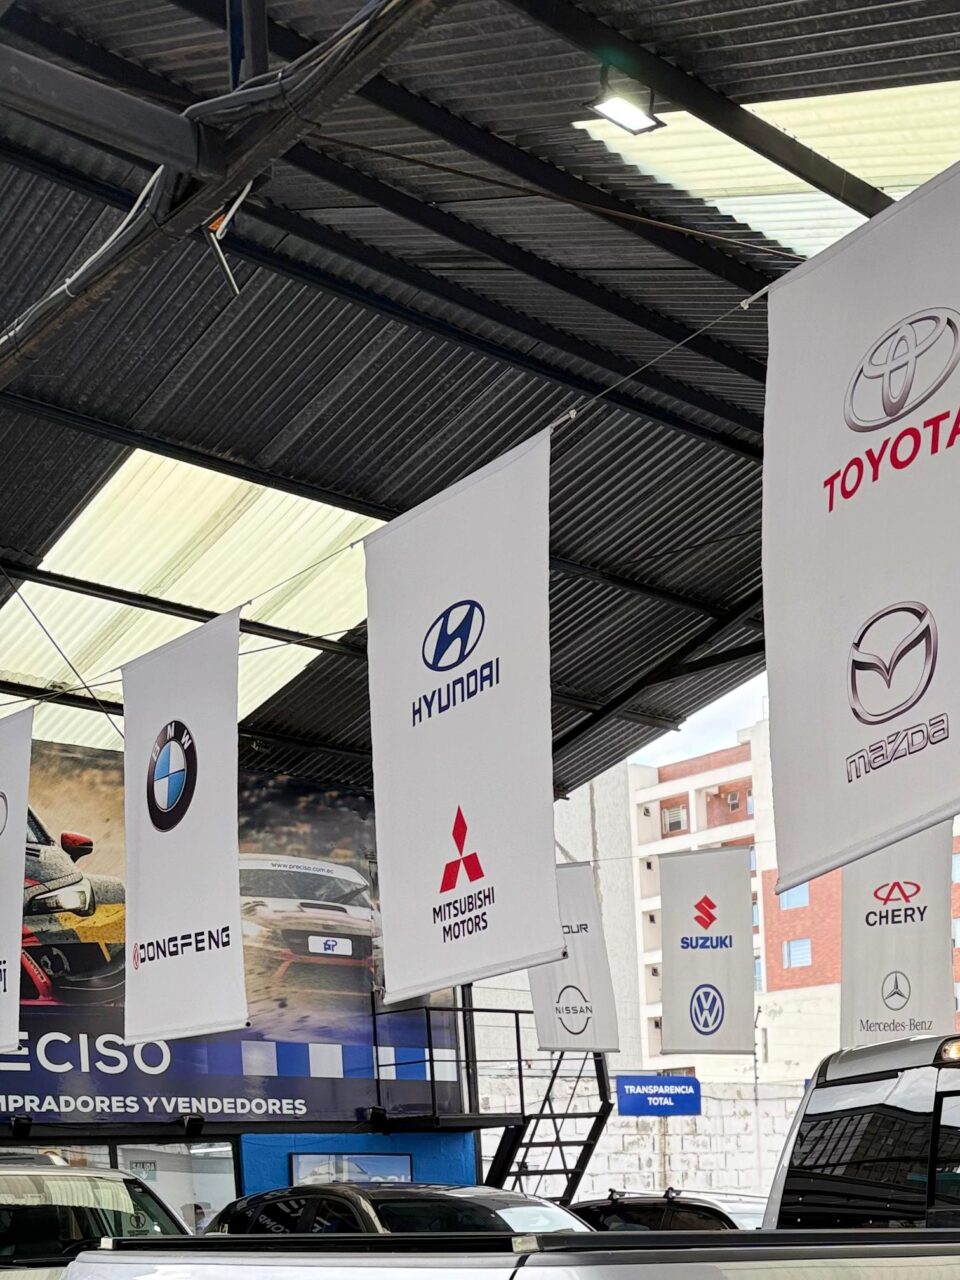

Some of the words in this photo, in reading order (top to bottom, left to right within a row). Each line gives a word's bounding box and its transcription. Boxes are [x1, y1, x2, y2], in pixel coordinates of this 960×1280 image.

[411, 657, 501, 727] HYUNDAI
[432, 886, 496, 925] MITSUBISHI
[865, 905, 928, 927] CHERY
[441, 911, 488, 943] MOTORS
[138, 925, 231, 964] DONGFENG
[680, 934, 732, 950] SUZUKI
[555, 1004, 593, 1015] NISSAN
[859, 1017, 933, 1033] Mercedes-Benz
[623, 1084, 694, 1095] TRANSPARENCIA
[142, 1096, 158, 1113] Y
[162, 1096, 307, 1116] VENDEDORES
[647, 1096, 675, 1107] TOTAL
